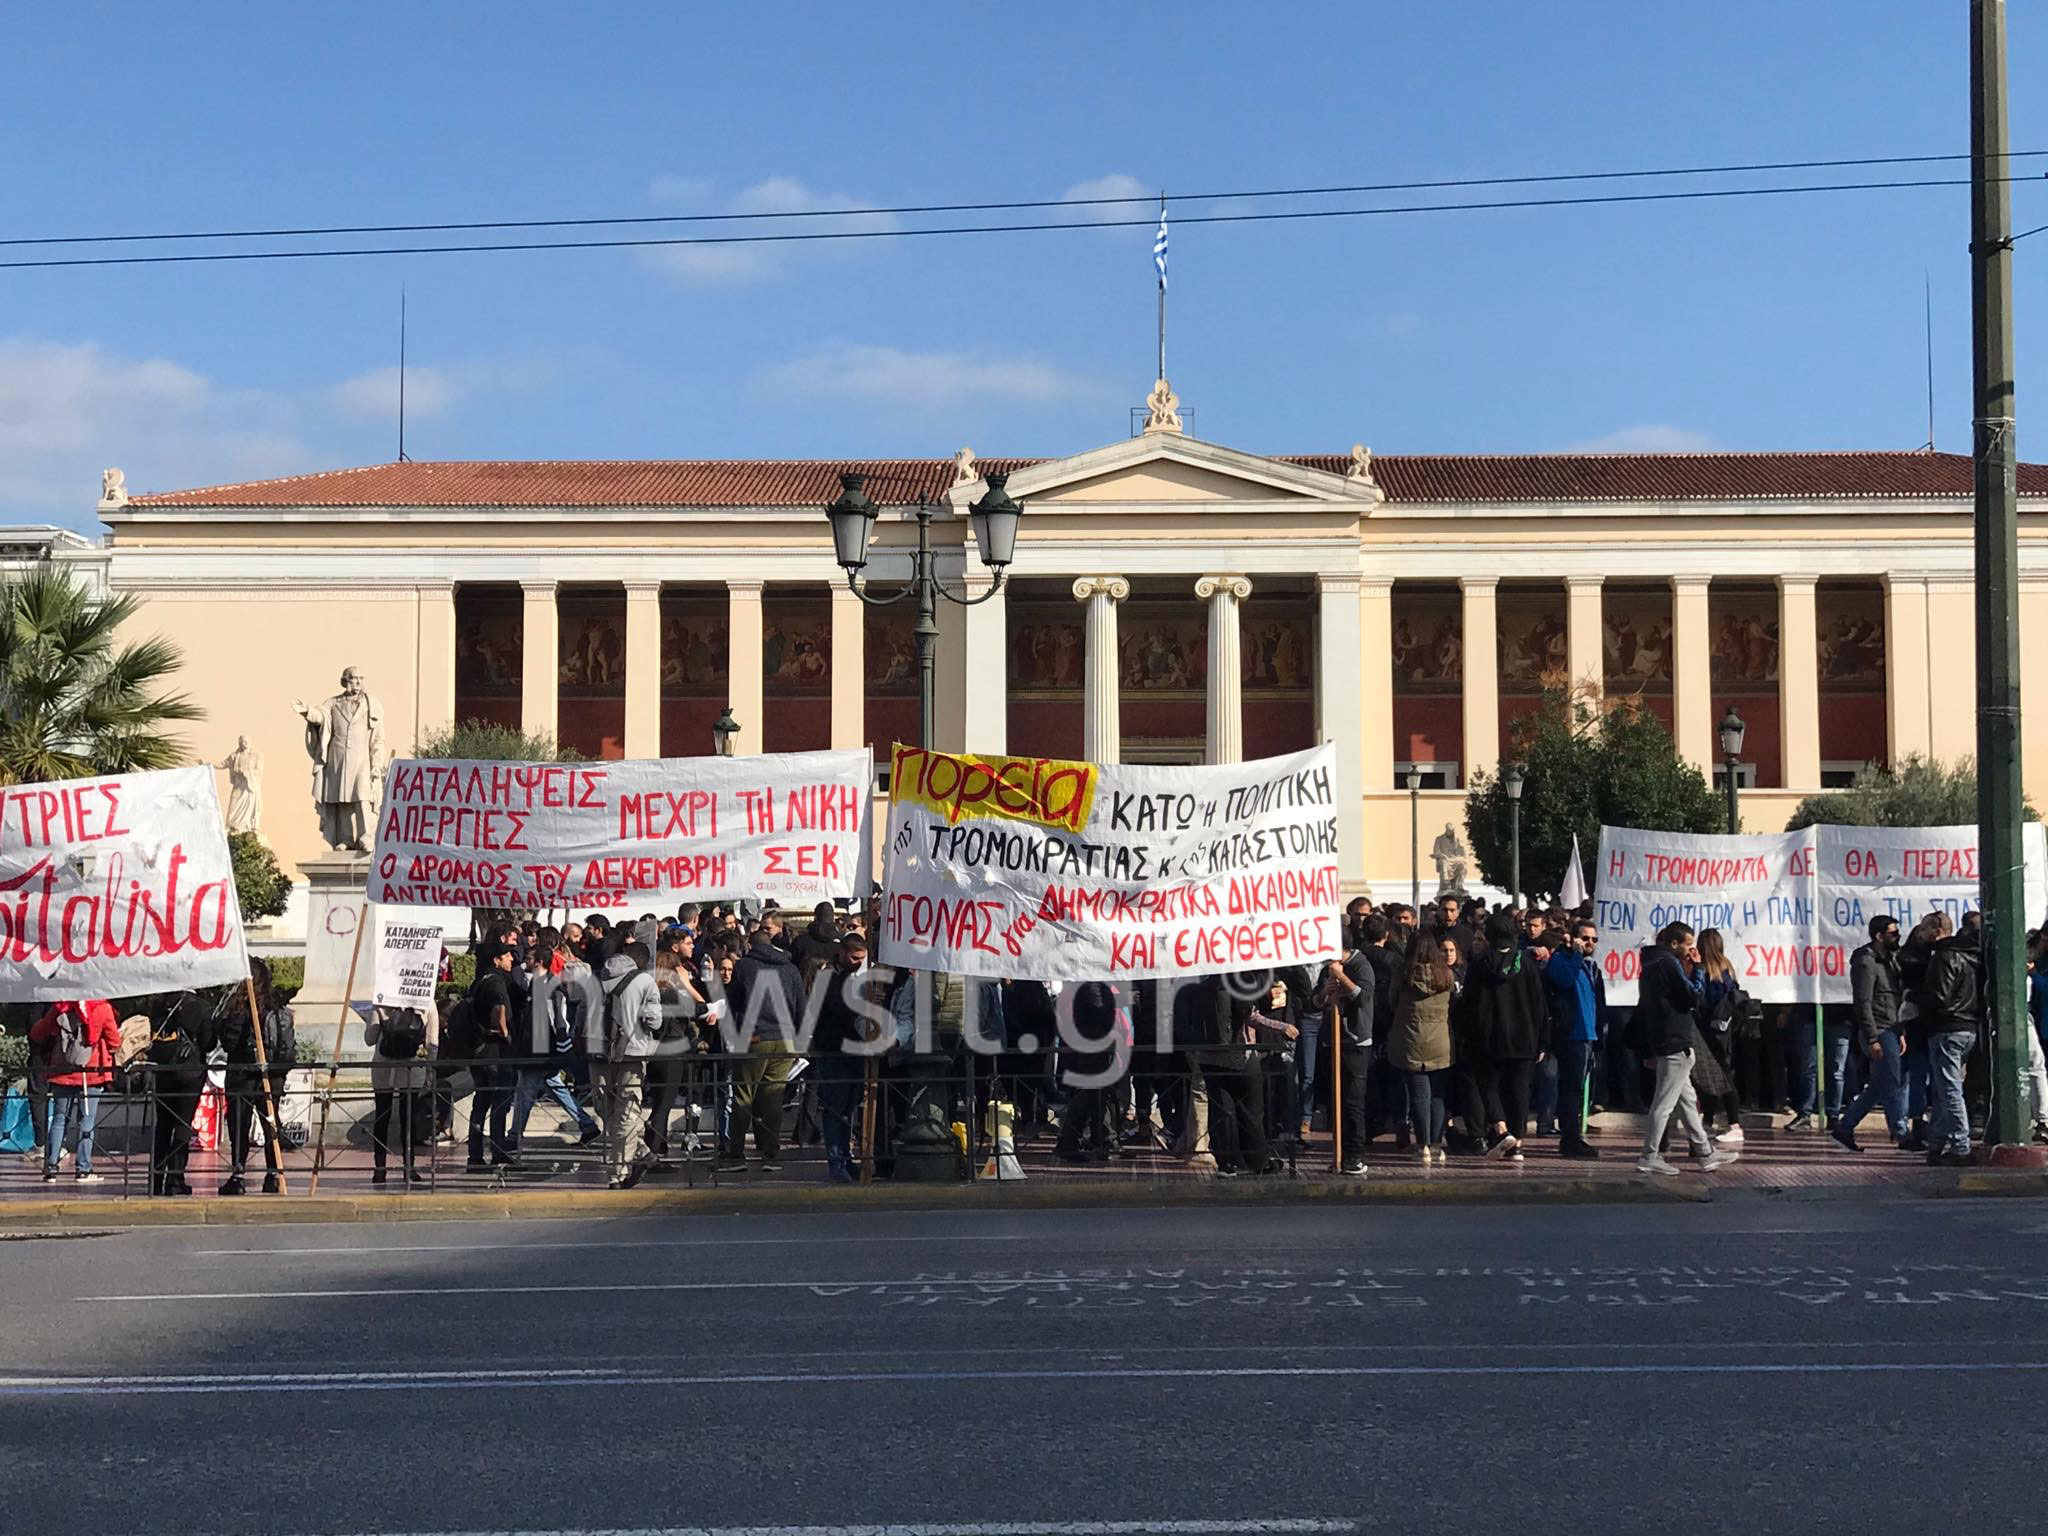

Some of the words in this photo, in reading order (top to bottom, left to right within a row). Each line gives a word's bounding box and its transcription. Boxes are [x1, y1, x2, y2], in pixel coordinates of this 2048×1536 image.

[392, 766, 608, 808] ΚΑΤΑΛΗΨΕΙΣ
[1111, 790, 1197, 832] ΚΑΤΩ
[1225, 766, 1333, 823] ΠΟΛΙΤΙΚΗ
[383, 806, 531, 851] ΑΠΕΡΓΙΕΣ
[619, 790, 719, 840] ΜΕΧΡΙ
[735, 786, 775, 836] ΤΗ
[785, 784, 859, 833] ΝΙΚΗ
[763, 843, 838, 879] ΣΕΚ
[929, 825, 1149, 881] ΤΡΟΜΟΚΡΑΤΙΑΣ
[1207, 816, 1339, 874] ΚΑΤΑΣΤΟΛΗΣ
[1609, 849, 1625, 878] Η
[1644, 853, 1769, 886] ΤΡΟΜΟΚΡΑΤΙΑ
[1788, 847, 1815, 877] ΔΕ
[1844, 849, 1879, 877] ΘΑ
[380, 852, 397, 880] Ο
[408, 855, 512, 891] ΔΡΟΜΟΣ
[523, 863, 572, 899] ΤΟΥ
[582, 853, 727, 890] ΔΕΚΕΜΒΡΗ
[886, 891, 1006, 956] ΑΓΩΝΑΣ
[1037, 882, 1221, 926] ΔΗΜΟΚΡΑΤΙΚΑ
[1743, 901, 1757, 927] Η
[1767, 896, 1813, 927] ΠΑΛΗ
[1834, 897, 1865, 927] ΘΑ
[384, 938, 427, 950] ΑΠΕΡΓΙΕΣ
[385, 926, 443, 938] ΚΑΤΑΛΗΨΕΙΣ
[1110, 931, 1156, 972] ΚΑΙ
[1174, 916, 1335, 969] ΕΛΕΥΘΕΡΙΕΣ
[399, 968, 434, 979] ΔΗΜΟΣΙΑ
[422, 962, 435, 970] ΓΙΑ
[1744, 944, 1844, 977] ΣΥΛΛΟΓΟΙ
[398, 986, 431, 997] ΠΑΙΔΕΙΑ
[402, 978, 432, 988] ΔΩΡΕΑΝ
